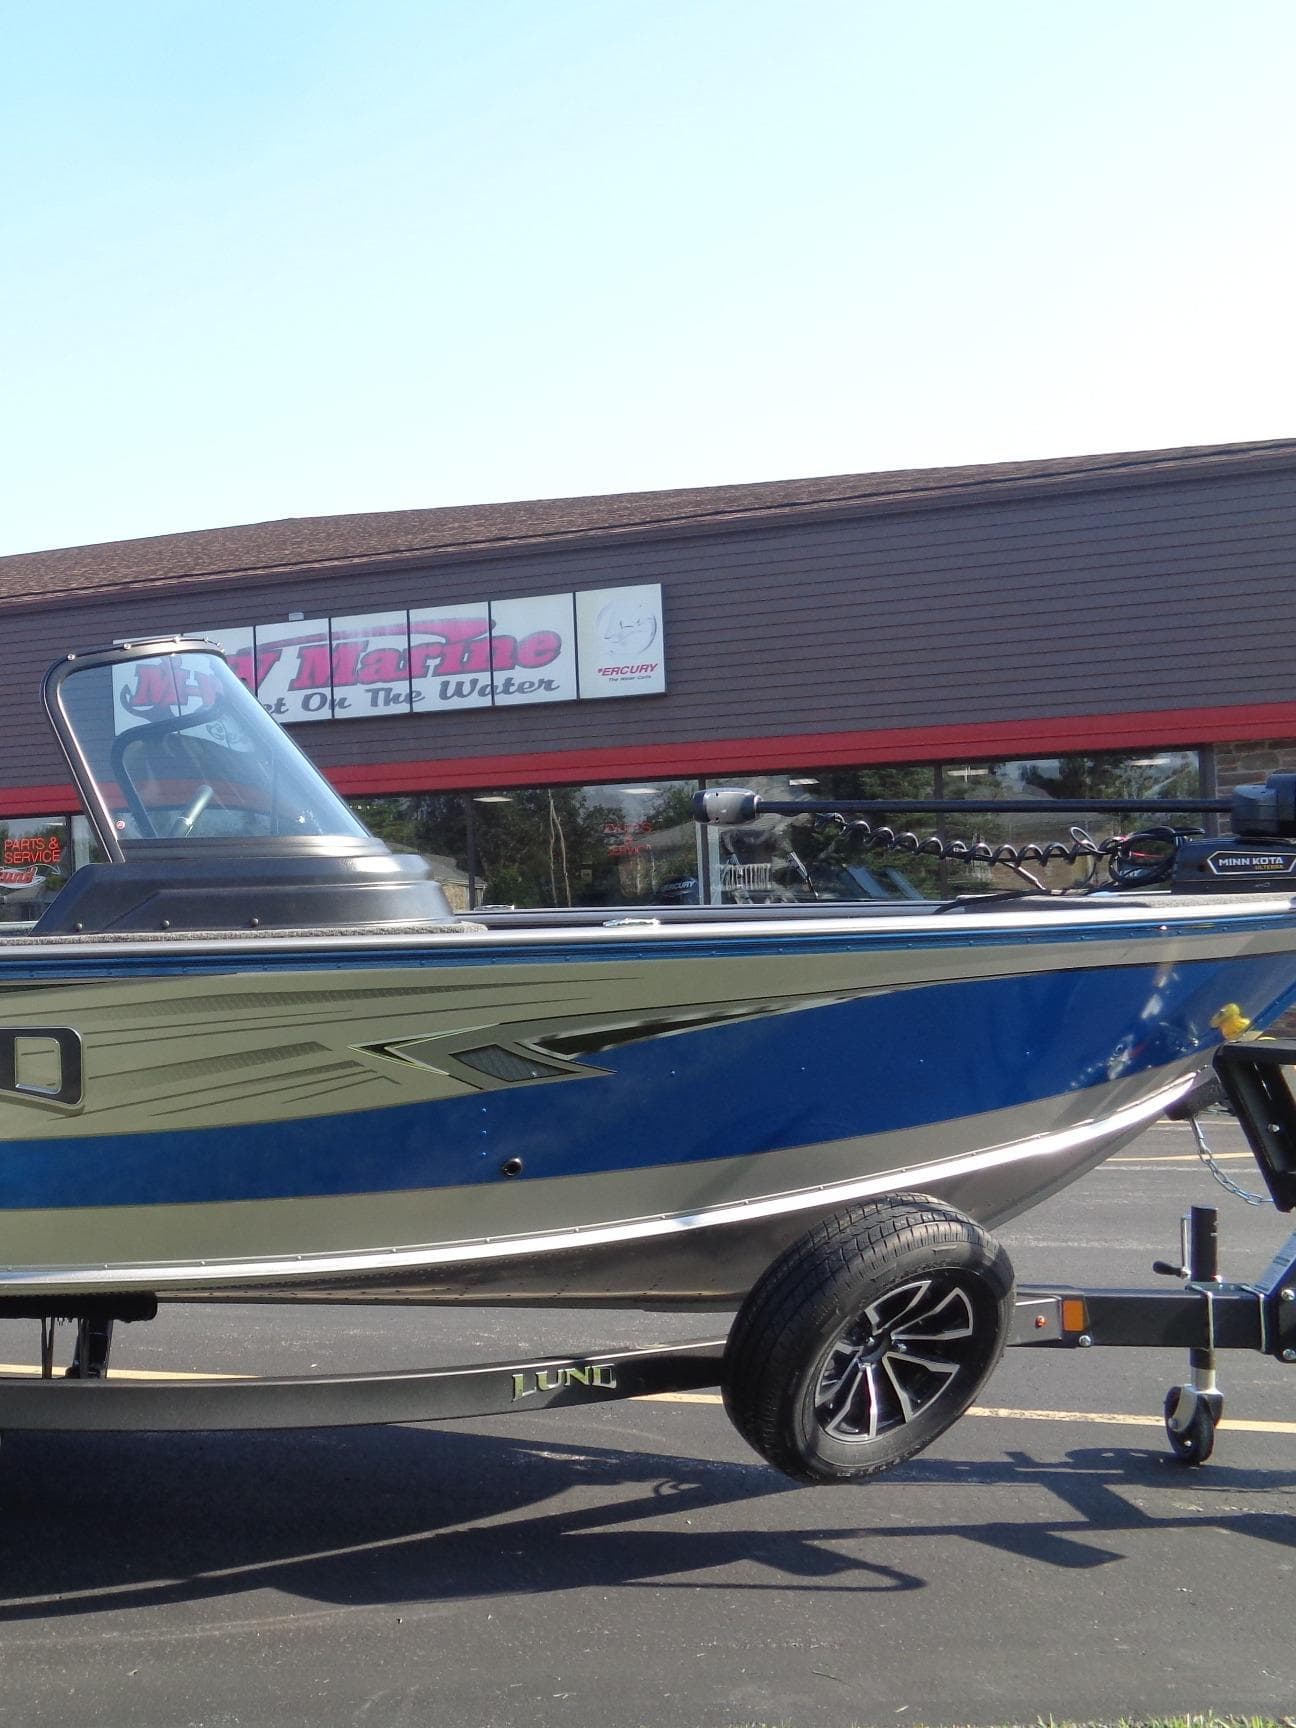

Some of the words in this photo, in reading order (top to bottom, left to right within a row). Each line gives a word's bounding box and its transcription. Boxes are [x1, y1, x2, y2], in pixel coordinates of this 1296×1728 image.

[288, 630, 562, 691] Marine
[597, 663, 658, 676] ERCURY
[263, 696, 290, 715] et
[302, 691, 351, 713] On
[365, 687, 425, 708] The
[438, 677, 560, 702] Water
[4, 837, 45, 851] PARTS
[48, 836, 60, 850] &
[4, 850, 62, 864] SERVICE
[1218, 858, 1250, 866] MINN
[1252, 856, 1284, 865] KOTA
[512, 1364, 617, 1402] LUND
